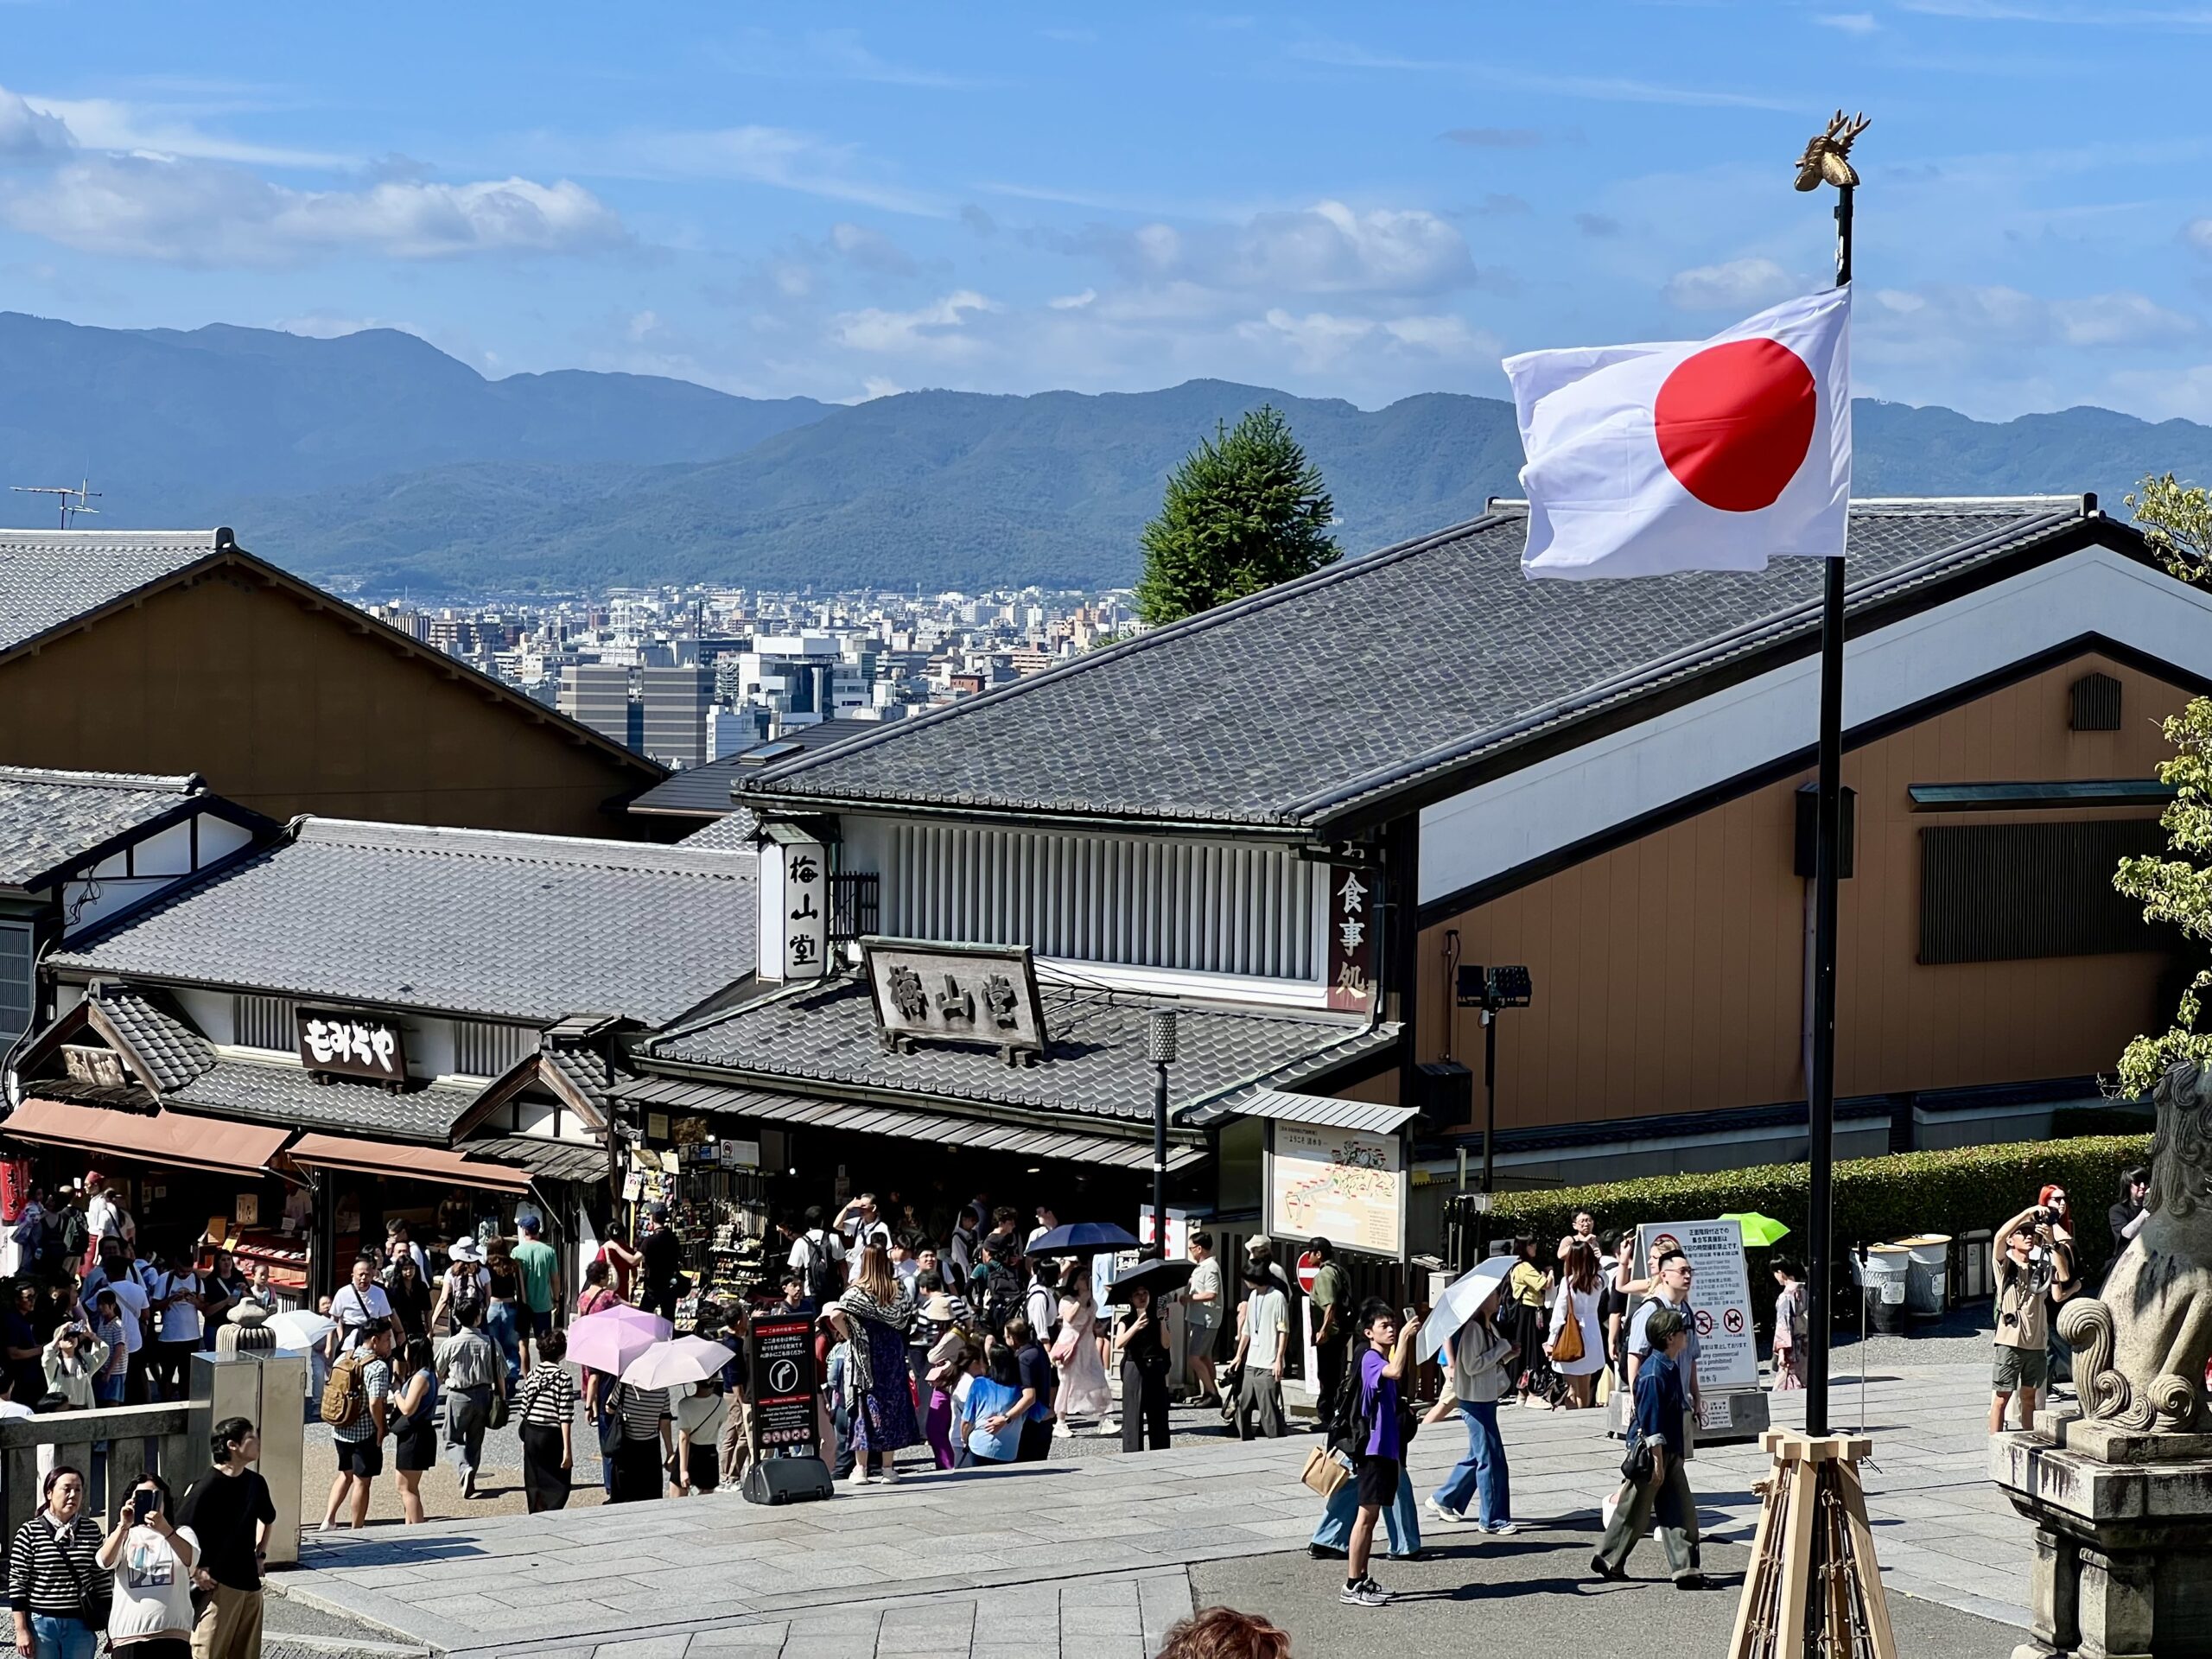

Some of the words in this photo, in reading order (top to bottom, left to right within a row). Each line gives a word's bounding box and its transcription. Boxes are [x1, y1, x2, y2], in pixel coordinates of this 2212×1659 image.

[790, 855, 819, 967] 梅山堂
[887, 964, 1018, 1028] 梅山堂
[304, 1018, 394, 1073] もみぢや
